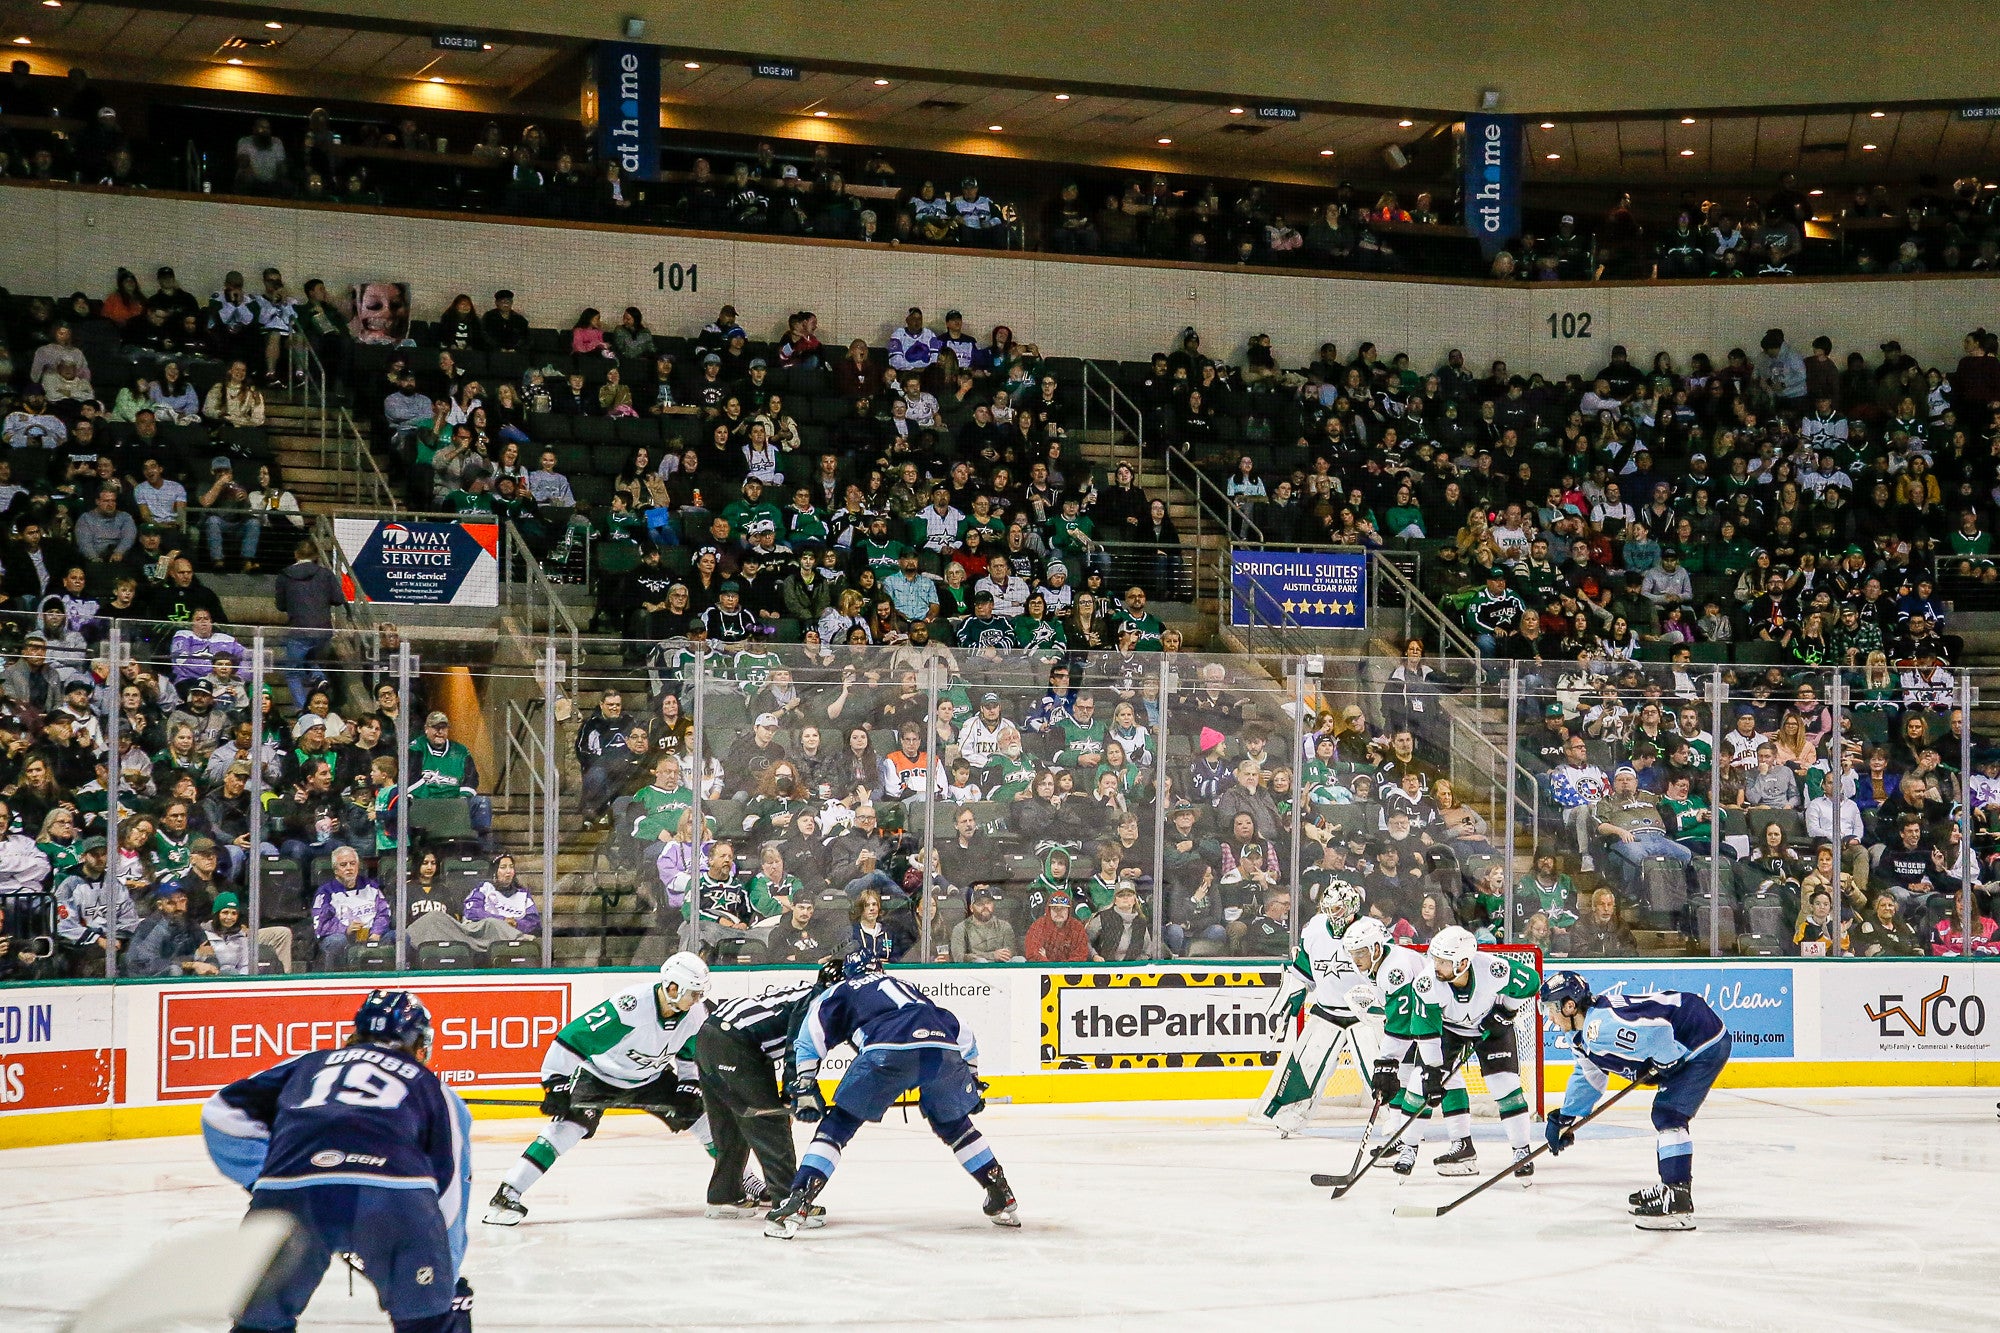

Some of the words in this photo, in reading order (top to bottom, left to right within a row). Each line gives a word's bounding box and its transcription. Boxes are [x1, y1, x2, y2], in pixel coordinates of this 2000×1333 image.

[439, 36, 462, 47] LOGE
[463, 38, 478, 48] 201
[758, 66, 780, 76] LOGE
[781, 67, 794, 77] 201
[1259, 107, 1280, 117] LOGE
[1280, 108, 1297, 118] 202A
[1962, 109, 1984, 117] LOGE
[617, 144, 640, 173] at
[1480, 207, 1501, 233] at
[653, 262, 698, 292] 101
[1547, 312, 1592, 339] 102
[411, 532, 451, 545] WAY
[1502, 537, 1527, 546] STARS
[382, 552, 452, 566] SERVICE
[386, 571, 403, 579] Call
[404, 571, 415, 579] for
[416, 572, 447, 580] Service!
[1235, 562, 1313, 577] SPRINGHILL
[1315, 565, 1359, 579] SUITES
[1283, 583, 1311, 592] AUSTIN
[1311, 584, 1337, 592] CEDAR
[1338, 584, 1358, 593] PARK
[976, 741, 998, 754] TEX
[1029, 891, 1044, 908] 29
[1560, 889, 1568, 900] C
[1951, 936, 1989, 944] TEAS
[1512, 969, 1531, 989] 11
[1719, 981, 1782, 1011] Clean
[1414, 1001, 1427, 1019] 11
[28, 1004, 52, 1043] IN
[369, 1016, 387, 1032] 19
[584, 1005, 612, 1032] 21
[441, 1015, 558, 1051] SHOP
[1614, 1028, 1639, 1052] 16
[1487, 1051, 1512, 1061] CCM
[324, 1049, 421, 1080] GROSS
[431, 1069, 475, 1083] IFIED
[290, 1061, 410, 1110] 19
[553, 1084, 571, 1093] CC
[346, 1154, 387, 1168] CCM
